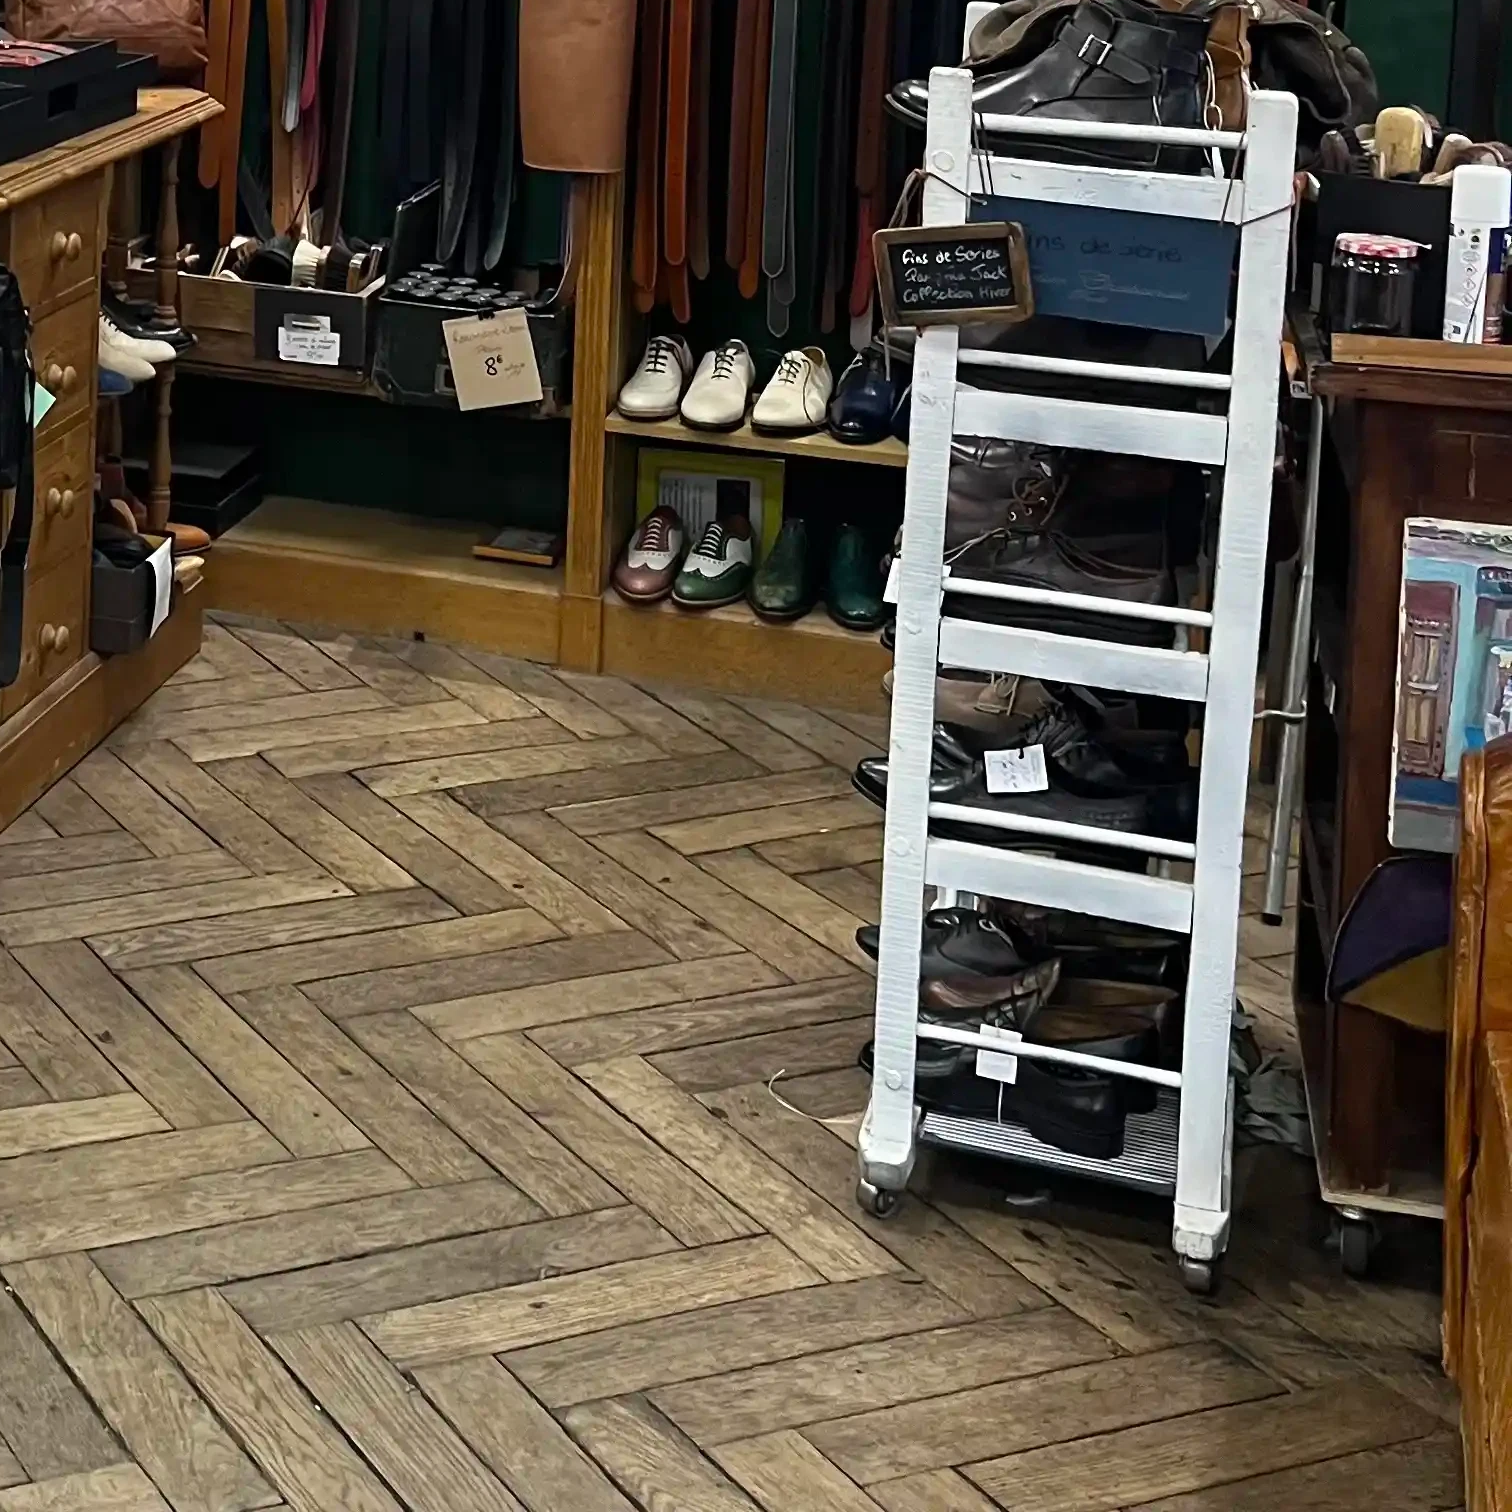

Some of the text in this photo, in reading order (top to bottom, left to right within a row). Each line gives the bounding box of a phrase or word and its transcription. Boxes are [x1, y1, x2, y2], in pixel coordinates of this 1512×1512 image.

[1029, 234, 1066, 251] ins
[935, 250, 952, 264] de
[970, 263, 1008, 281] Jack
